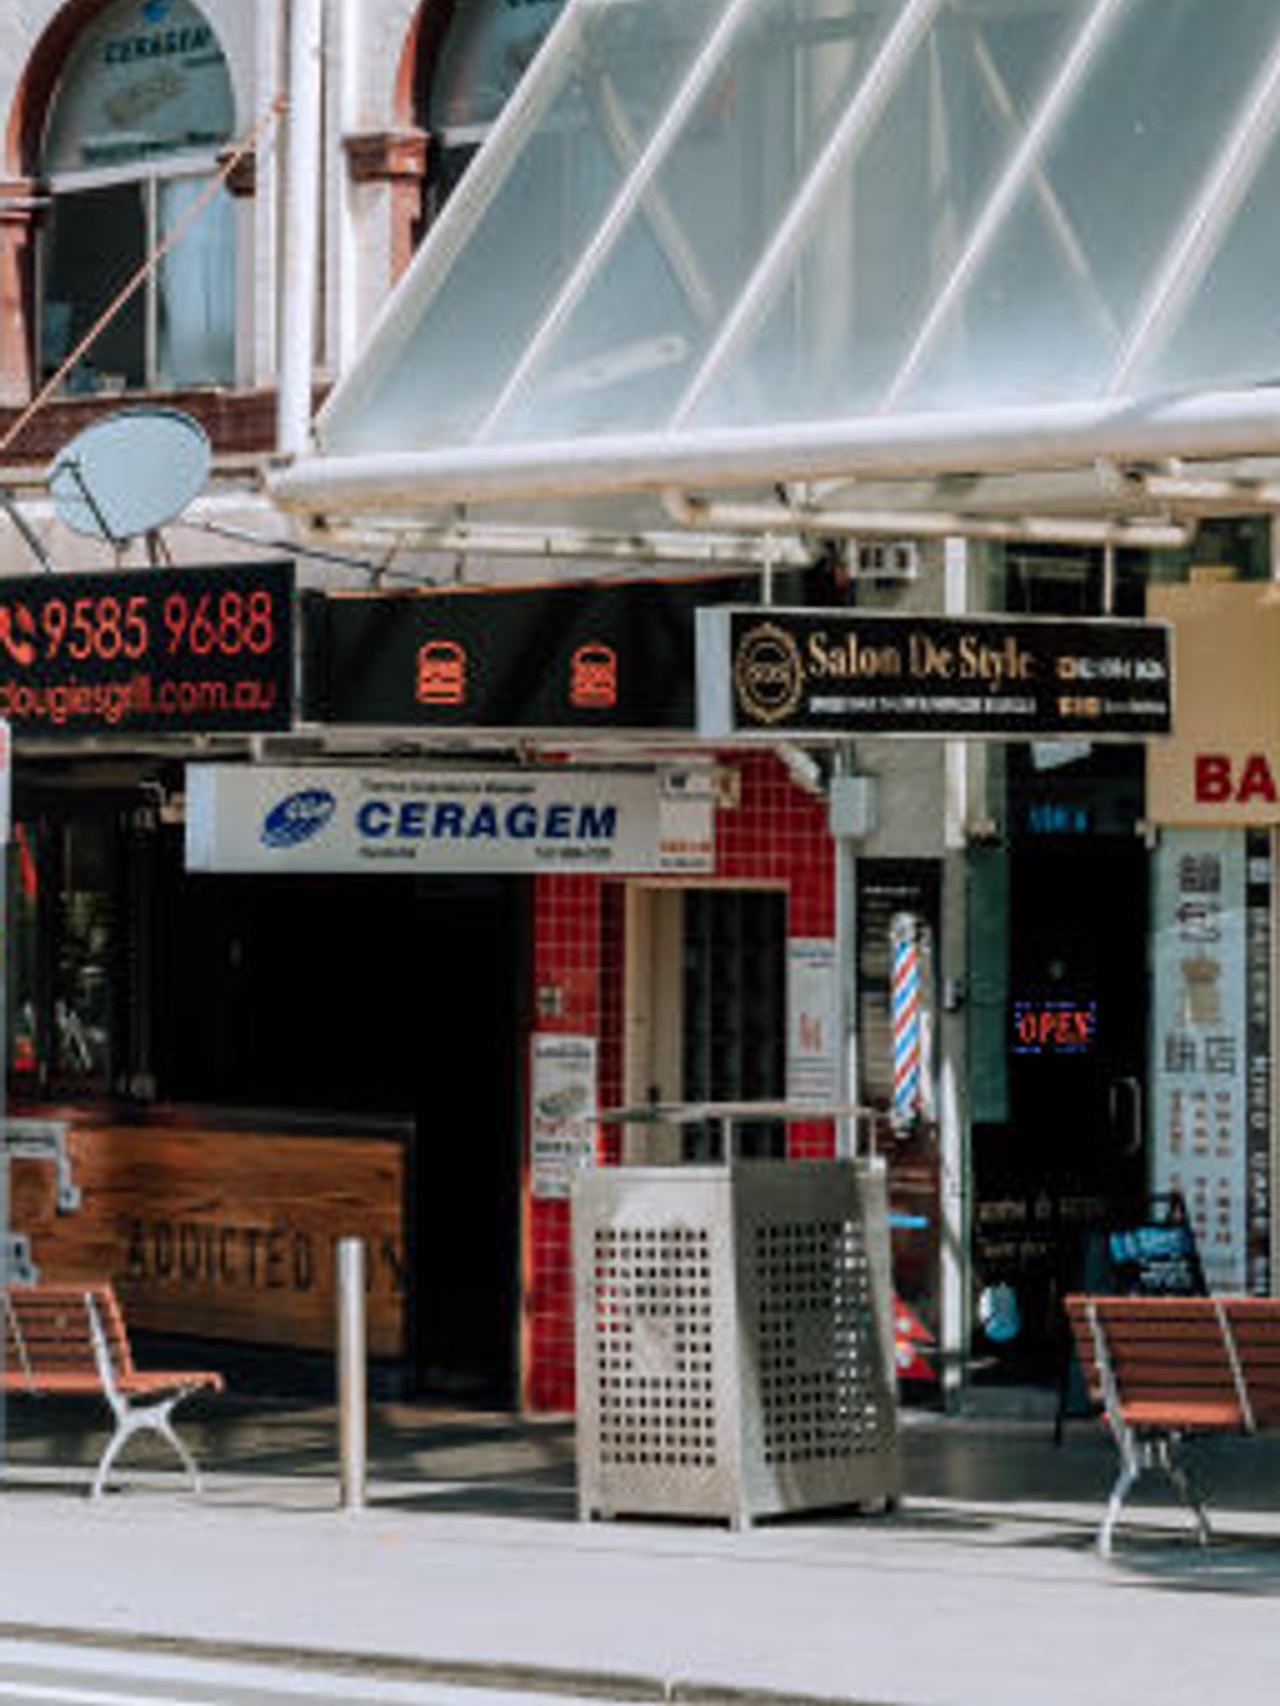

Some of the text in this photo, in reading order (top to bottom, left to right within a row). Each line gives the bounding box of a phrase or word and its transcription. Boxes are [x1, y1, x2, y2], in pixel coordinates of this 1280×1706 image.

[43, 591, 273, 660] 9585 9688
[808, 631, 899, 676] Salon
[909, 633, 951, 677] De
[959, 635, 1032, 693] Style
[355, 800, 618, 840] CERAGEM
[1019, 1011, 1092, 1044] OPEN
[129, 1216, 313, 1293] ADDICTED
